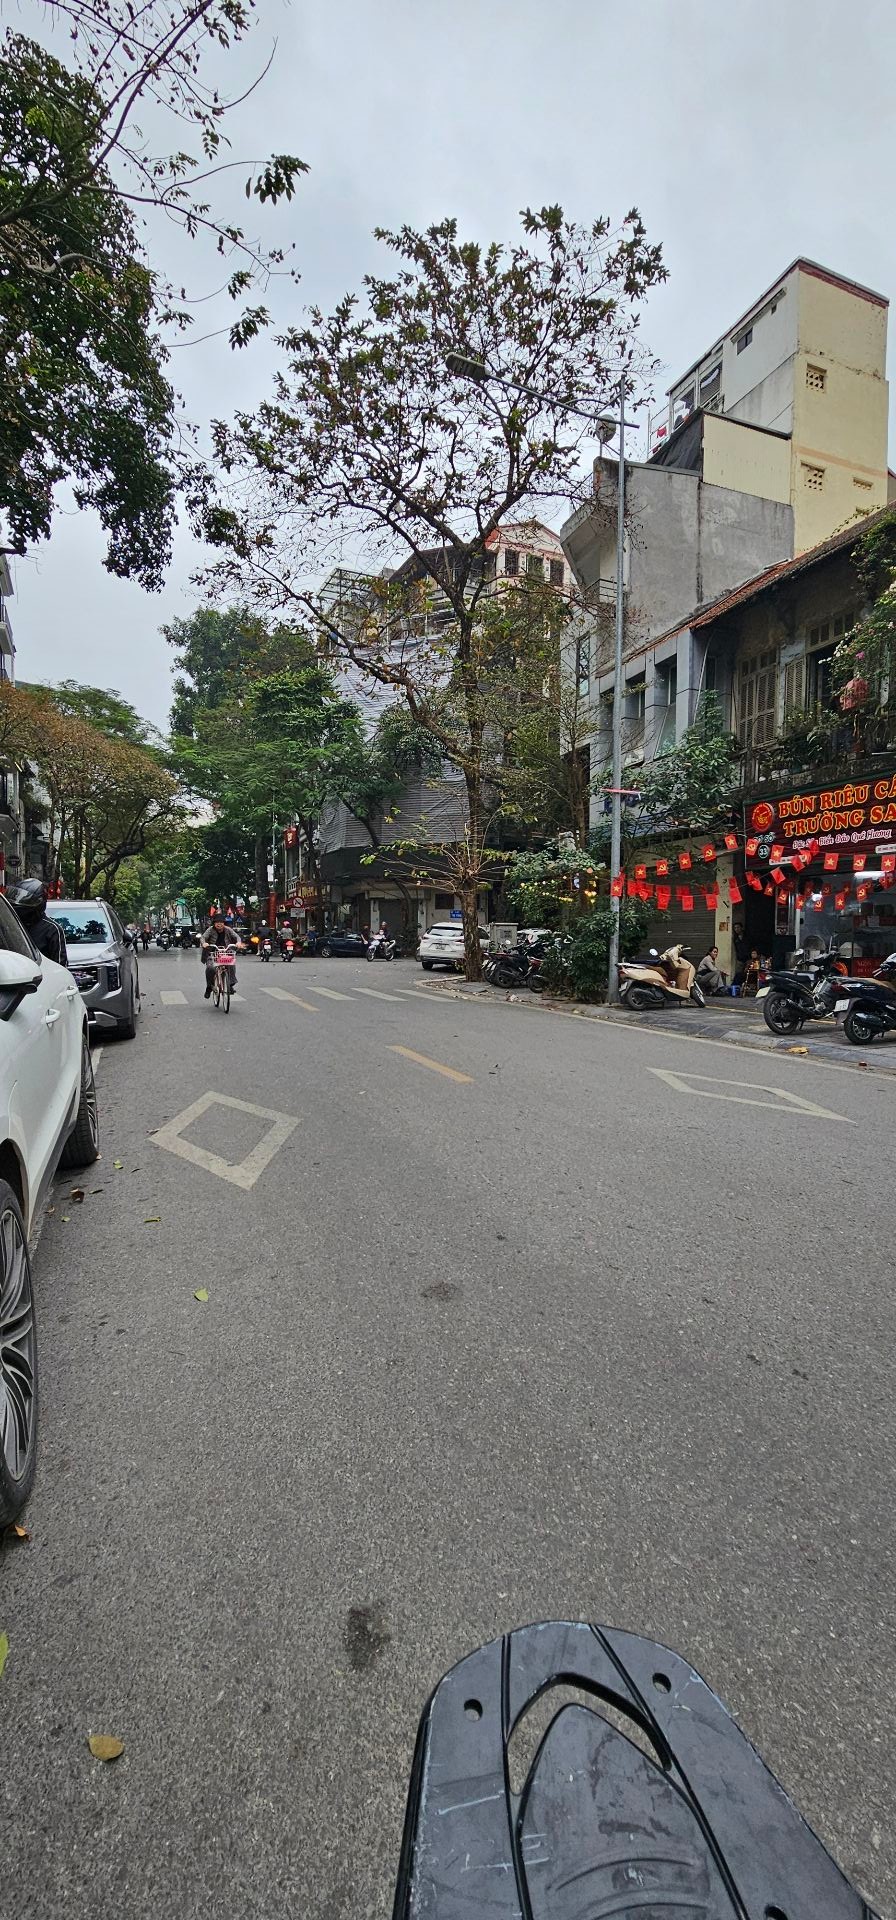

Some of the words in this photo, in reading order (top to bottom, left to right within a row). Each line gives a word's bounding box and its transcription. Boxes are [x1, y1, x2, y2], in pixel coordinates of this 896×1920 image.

[779, 795, 816, 818] BÚN
[820, 784, 869, 811] RIÊU
[783, 809, 866, 838] TRƯỜNG
[851, 830, 866, 843] Quê
[760, 848, 767, 856] 33
